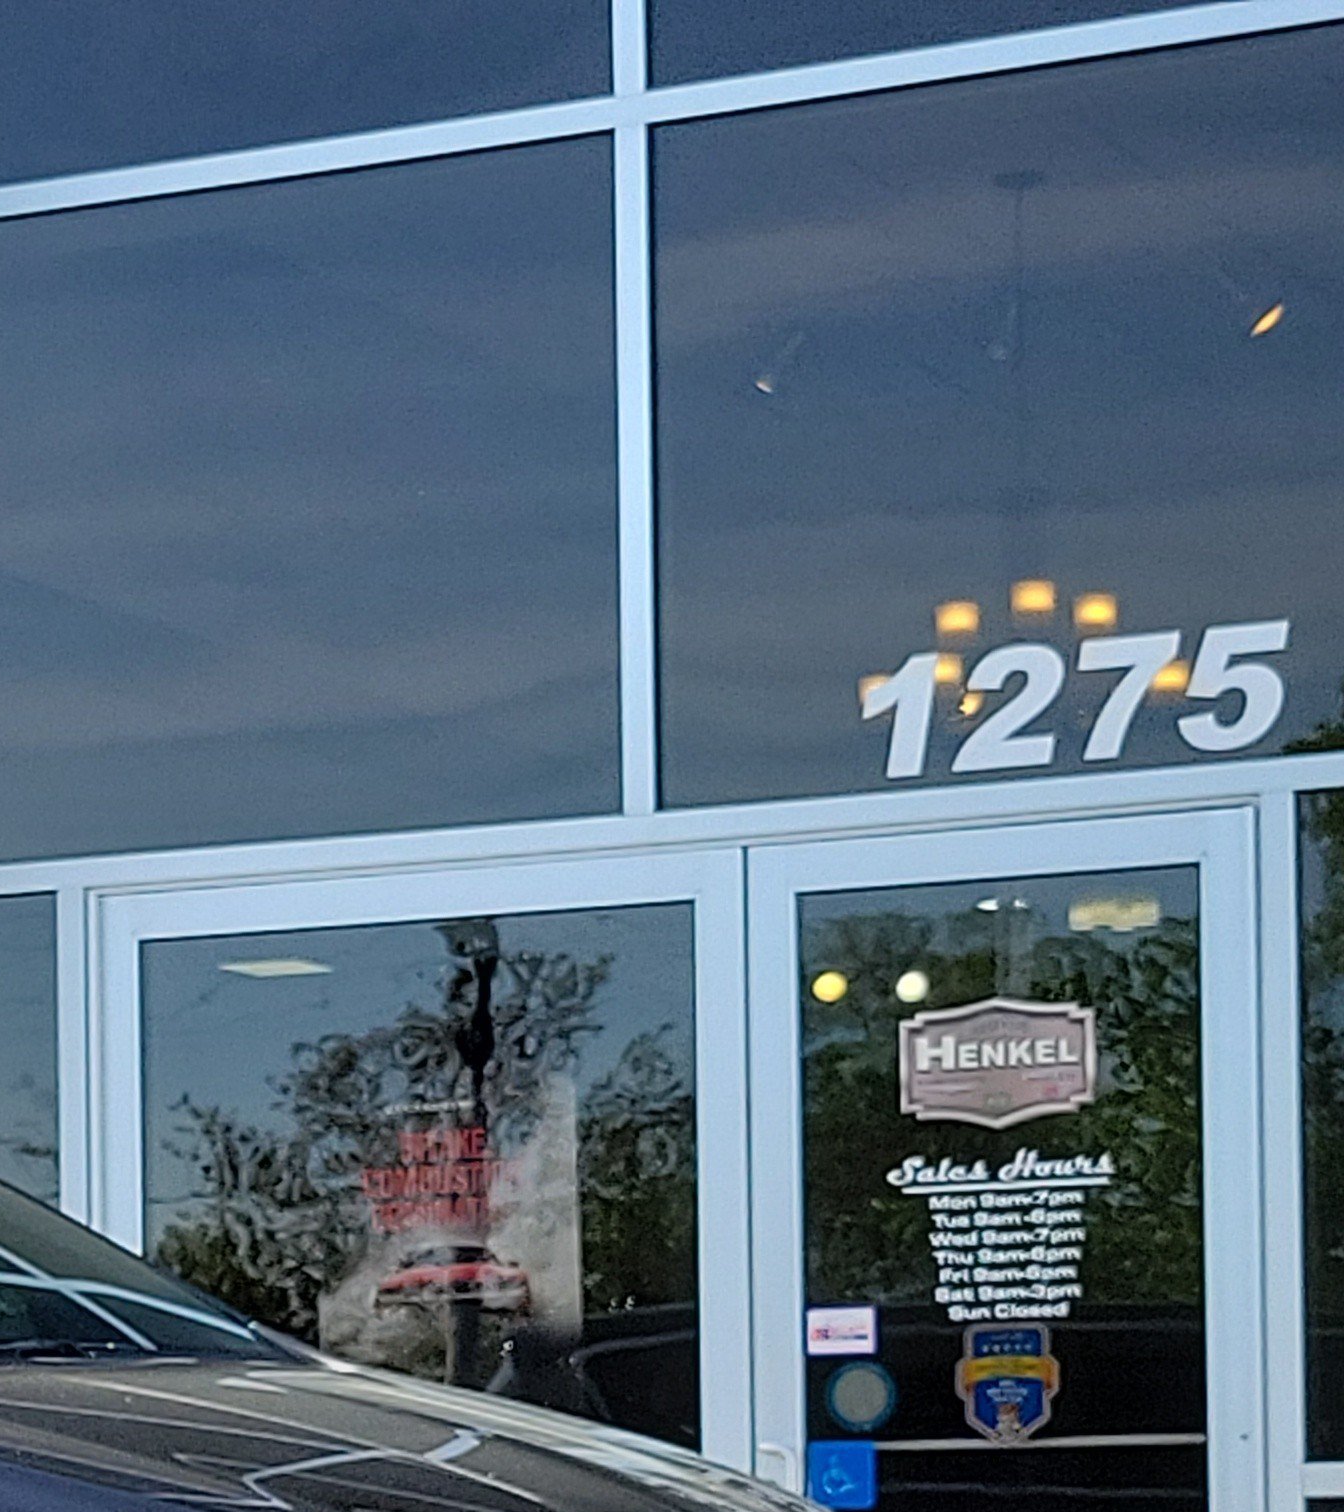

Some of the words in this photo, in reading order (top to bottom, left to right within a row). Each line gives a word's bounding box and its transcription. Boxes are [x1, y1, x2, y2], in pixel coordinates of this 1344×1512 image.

[861, 619, 1289, 779] 1275
[915, 1035, 1079, 1073] HENKEL
[886, 1155, 990, 1186] Sales
[998, 1147, 1115, 1181] Hours
[928, 1196, 977, 1211] Mon
[931, 1213, 971, 1229] Tue
[928, 1230, 979, 1248] Wed
[932, 1250, 975, 1266] Thu
[939, 1268, 972, 1284] Fri
[934, 1286, 976, 1303] Sat
[948, 1304, 991, 1322] Sun
[994, 1301, 1071, 1319] Closed
